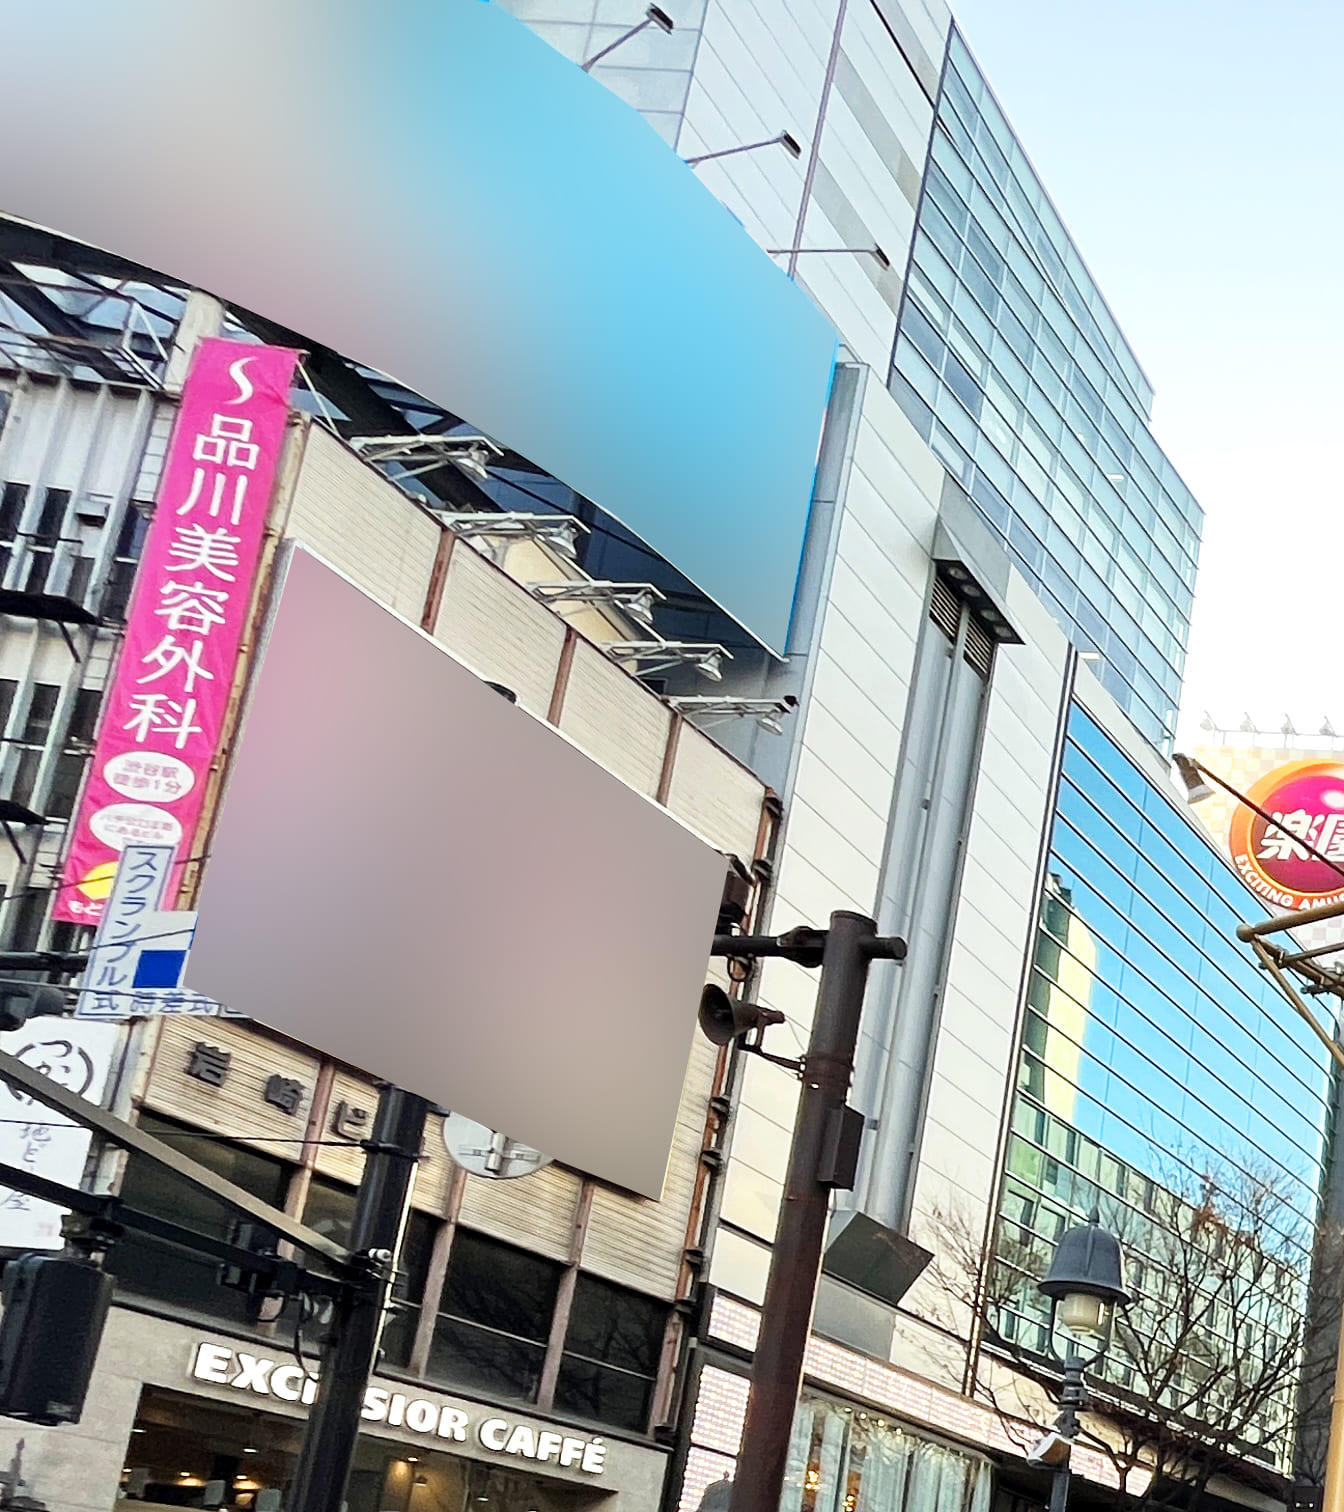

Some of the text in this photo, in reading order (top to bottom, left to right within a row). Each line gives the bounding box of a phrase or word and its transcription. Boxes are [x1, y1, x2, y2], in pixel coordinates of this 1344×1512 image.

[123, 413, 261, 750] 品川美容外科
[91, 851, 158, 1012] スクランブル式
[1234, 853, 1294, 908] EXCITING
[194, 1341, 608, 1475] EXCSIOR CAFFÉ
